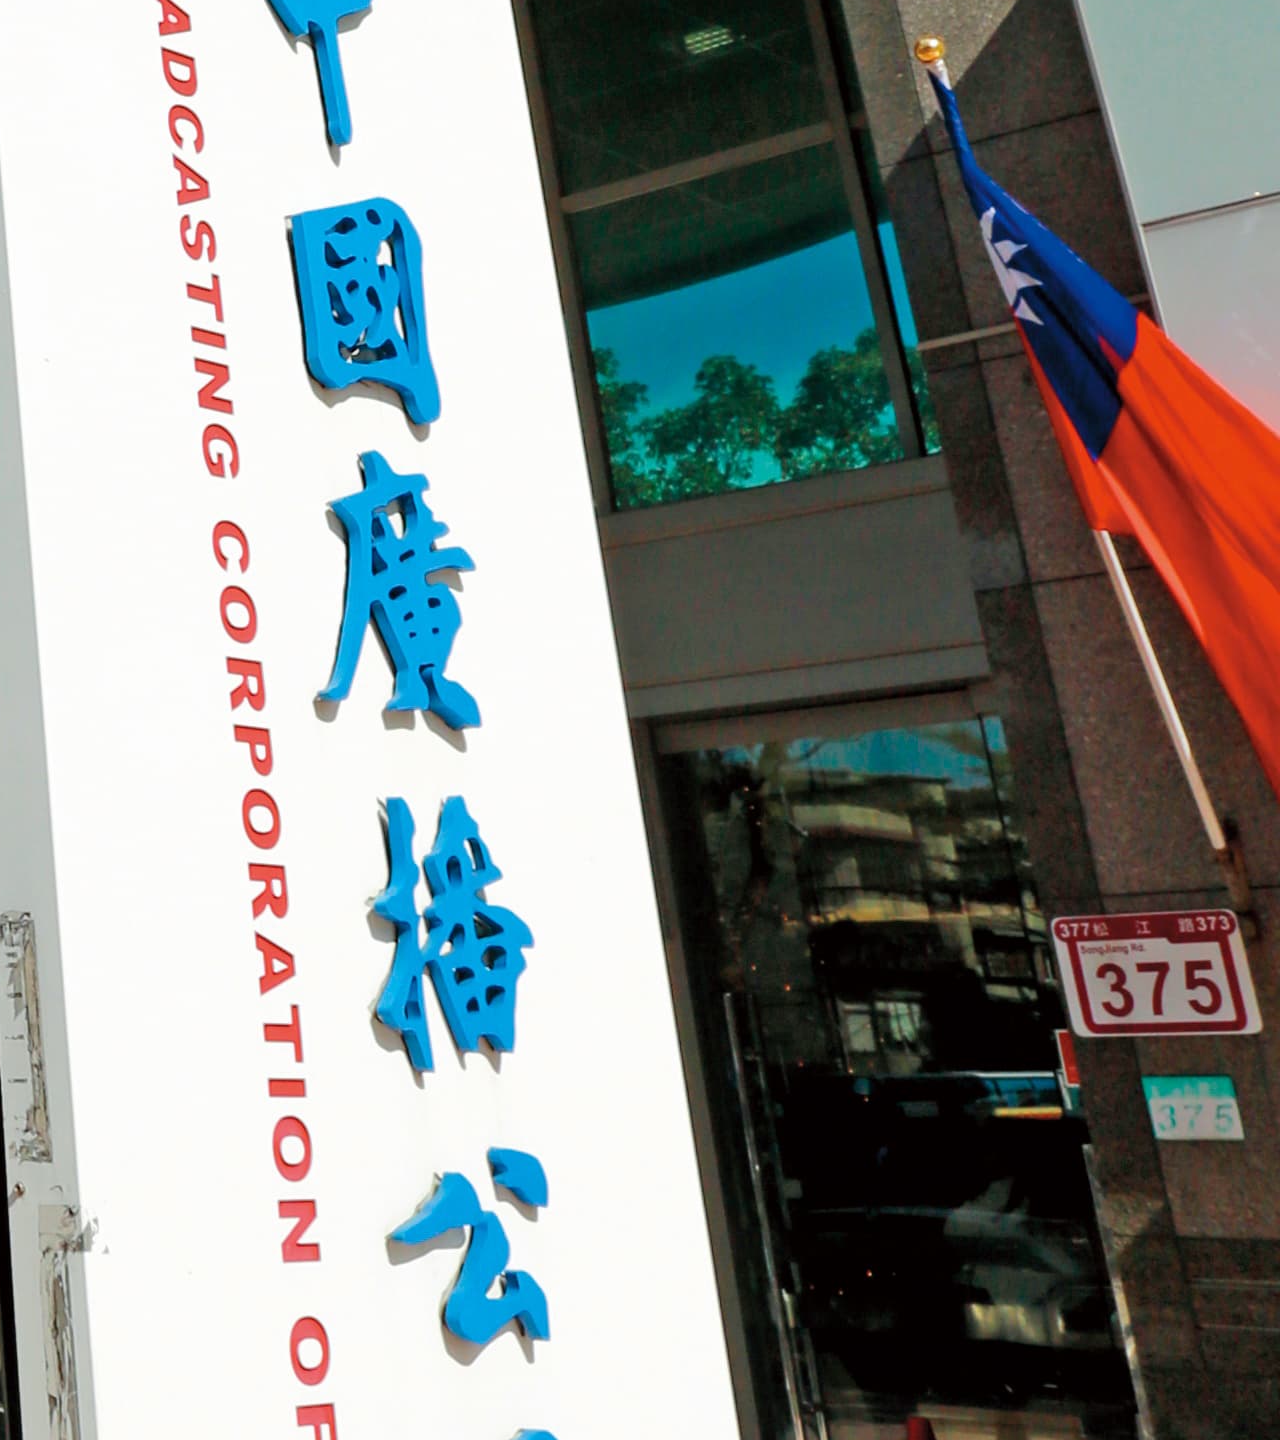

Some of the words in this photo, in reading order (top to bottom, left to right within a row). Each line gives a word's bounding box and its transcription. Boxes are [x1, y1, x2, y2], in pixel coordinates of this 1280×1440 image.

[211, 518, 322, 1265] CORPORATION
[1059, 923, 1089, 938] 377
[1197, 915, 1231, 932] 373
[1096, 960, 1222, 1018] 375
[1156, 1103, 1234, 1133] 375
